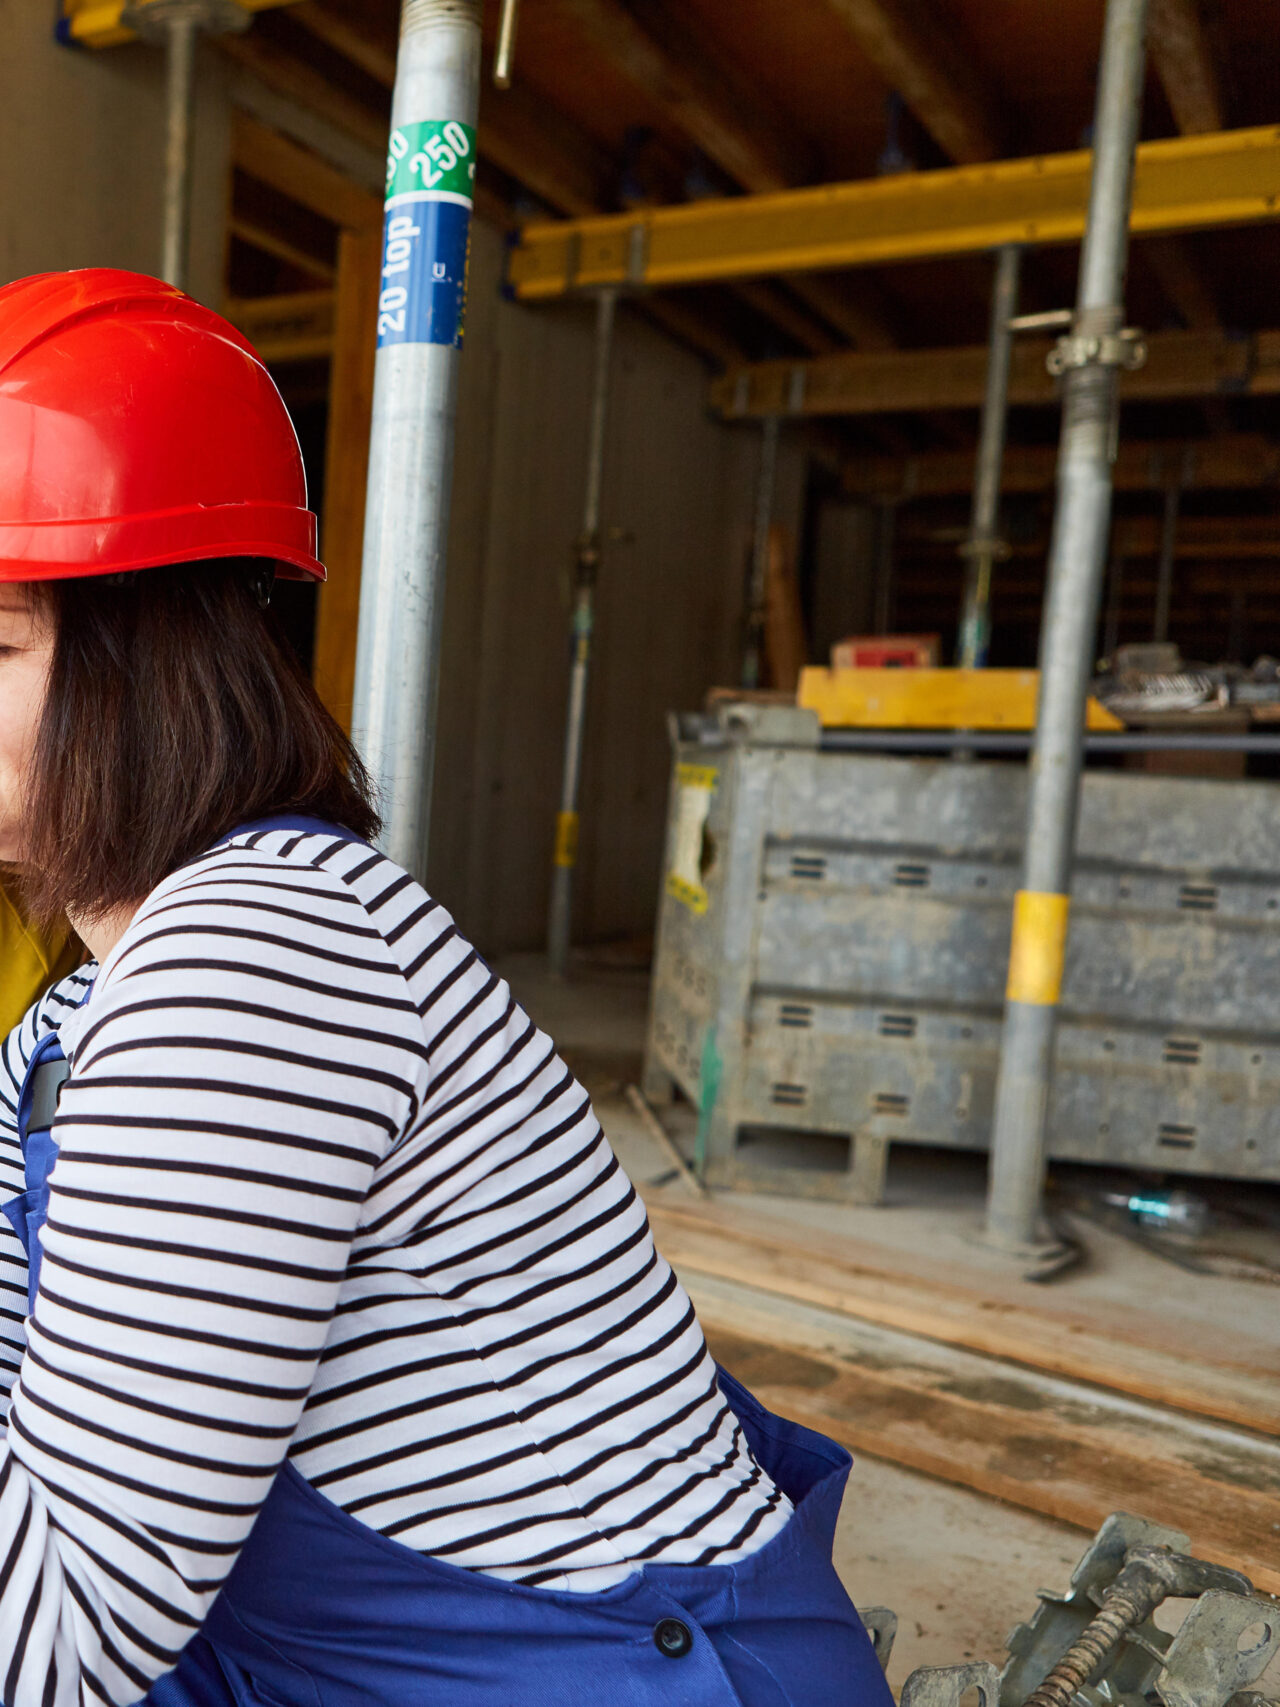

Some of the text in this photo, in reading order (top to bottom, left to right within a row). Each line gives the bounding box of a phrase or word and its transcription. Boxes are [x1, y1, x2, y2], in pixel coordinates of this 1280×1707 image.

[409, 121, 469, 189] 250
[378, 216, 421, 336] 20 top
